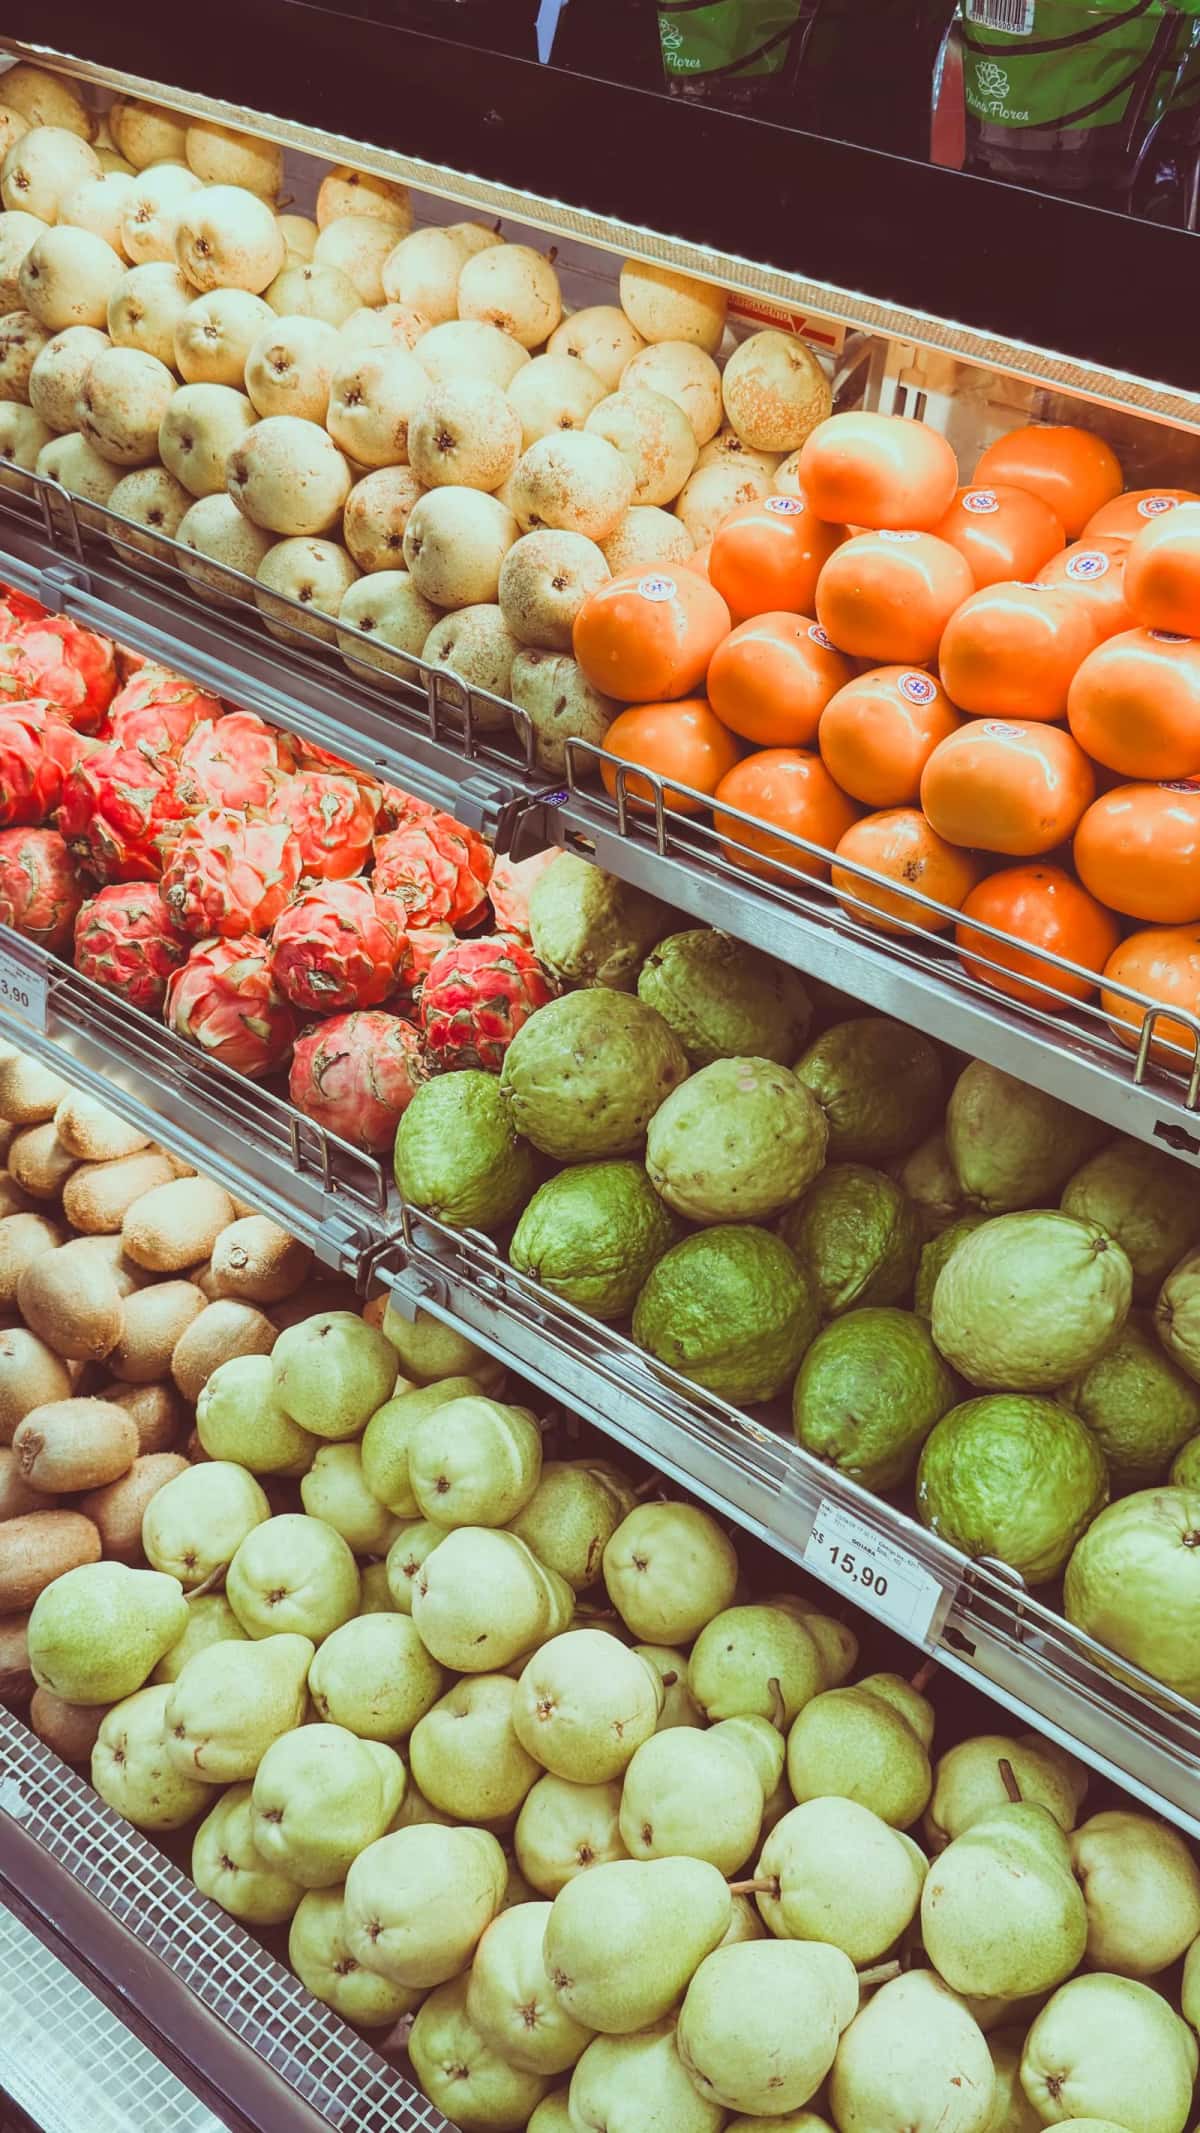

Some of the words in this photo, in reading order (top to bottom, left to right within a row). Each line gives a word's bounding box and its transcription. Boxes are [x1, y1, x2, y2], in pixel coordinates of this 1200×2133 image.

[664, 51, 701, 69] Flores
[989, 101, 1029, 120] Flores
[810, 1527, 825, 1544] R$
[829, 1546, 888, 1597] 15,90
